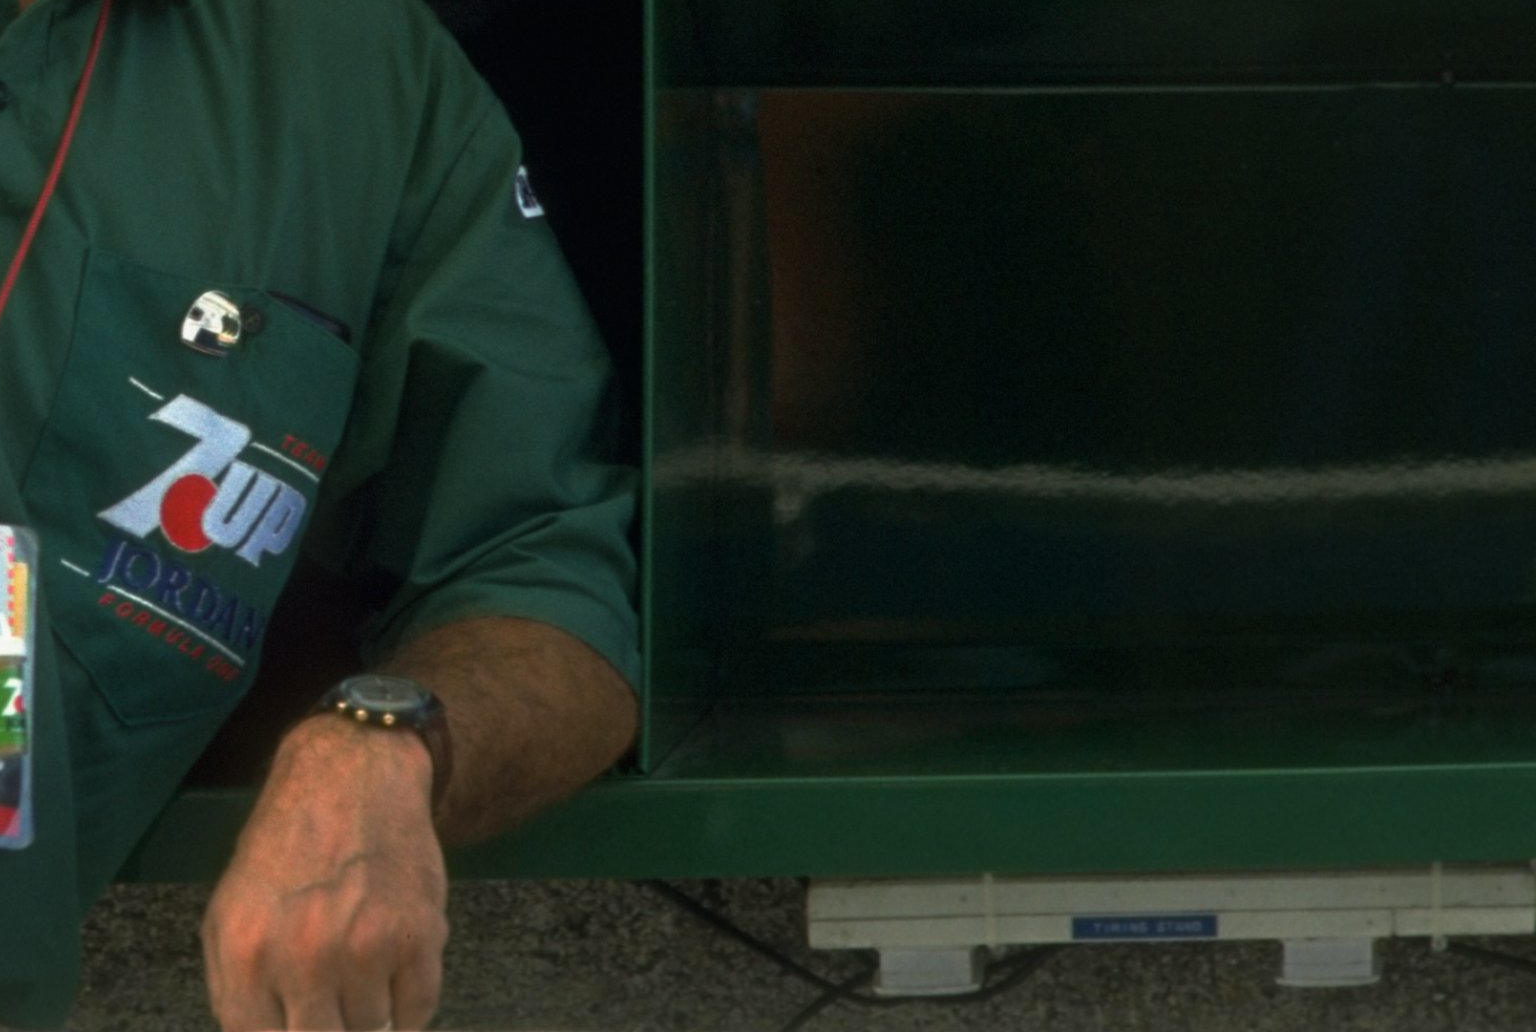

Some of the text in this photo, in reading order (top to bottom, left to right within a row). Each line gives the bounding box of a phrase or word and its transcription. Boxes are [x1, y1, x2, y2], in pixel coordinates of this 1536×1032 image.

[281, 434, 327, 470] TEAM
[97, 537, 262, 651] JORDAN
[97, 592, 205, 661] FORMULA
